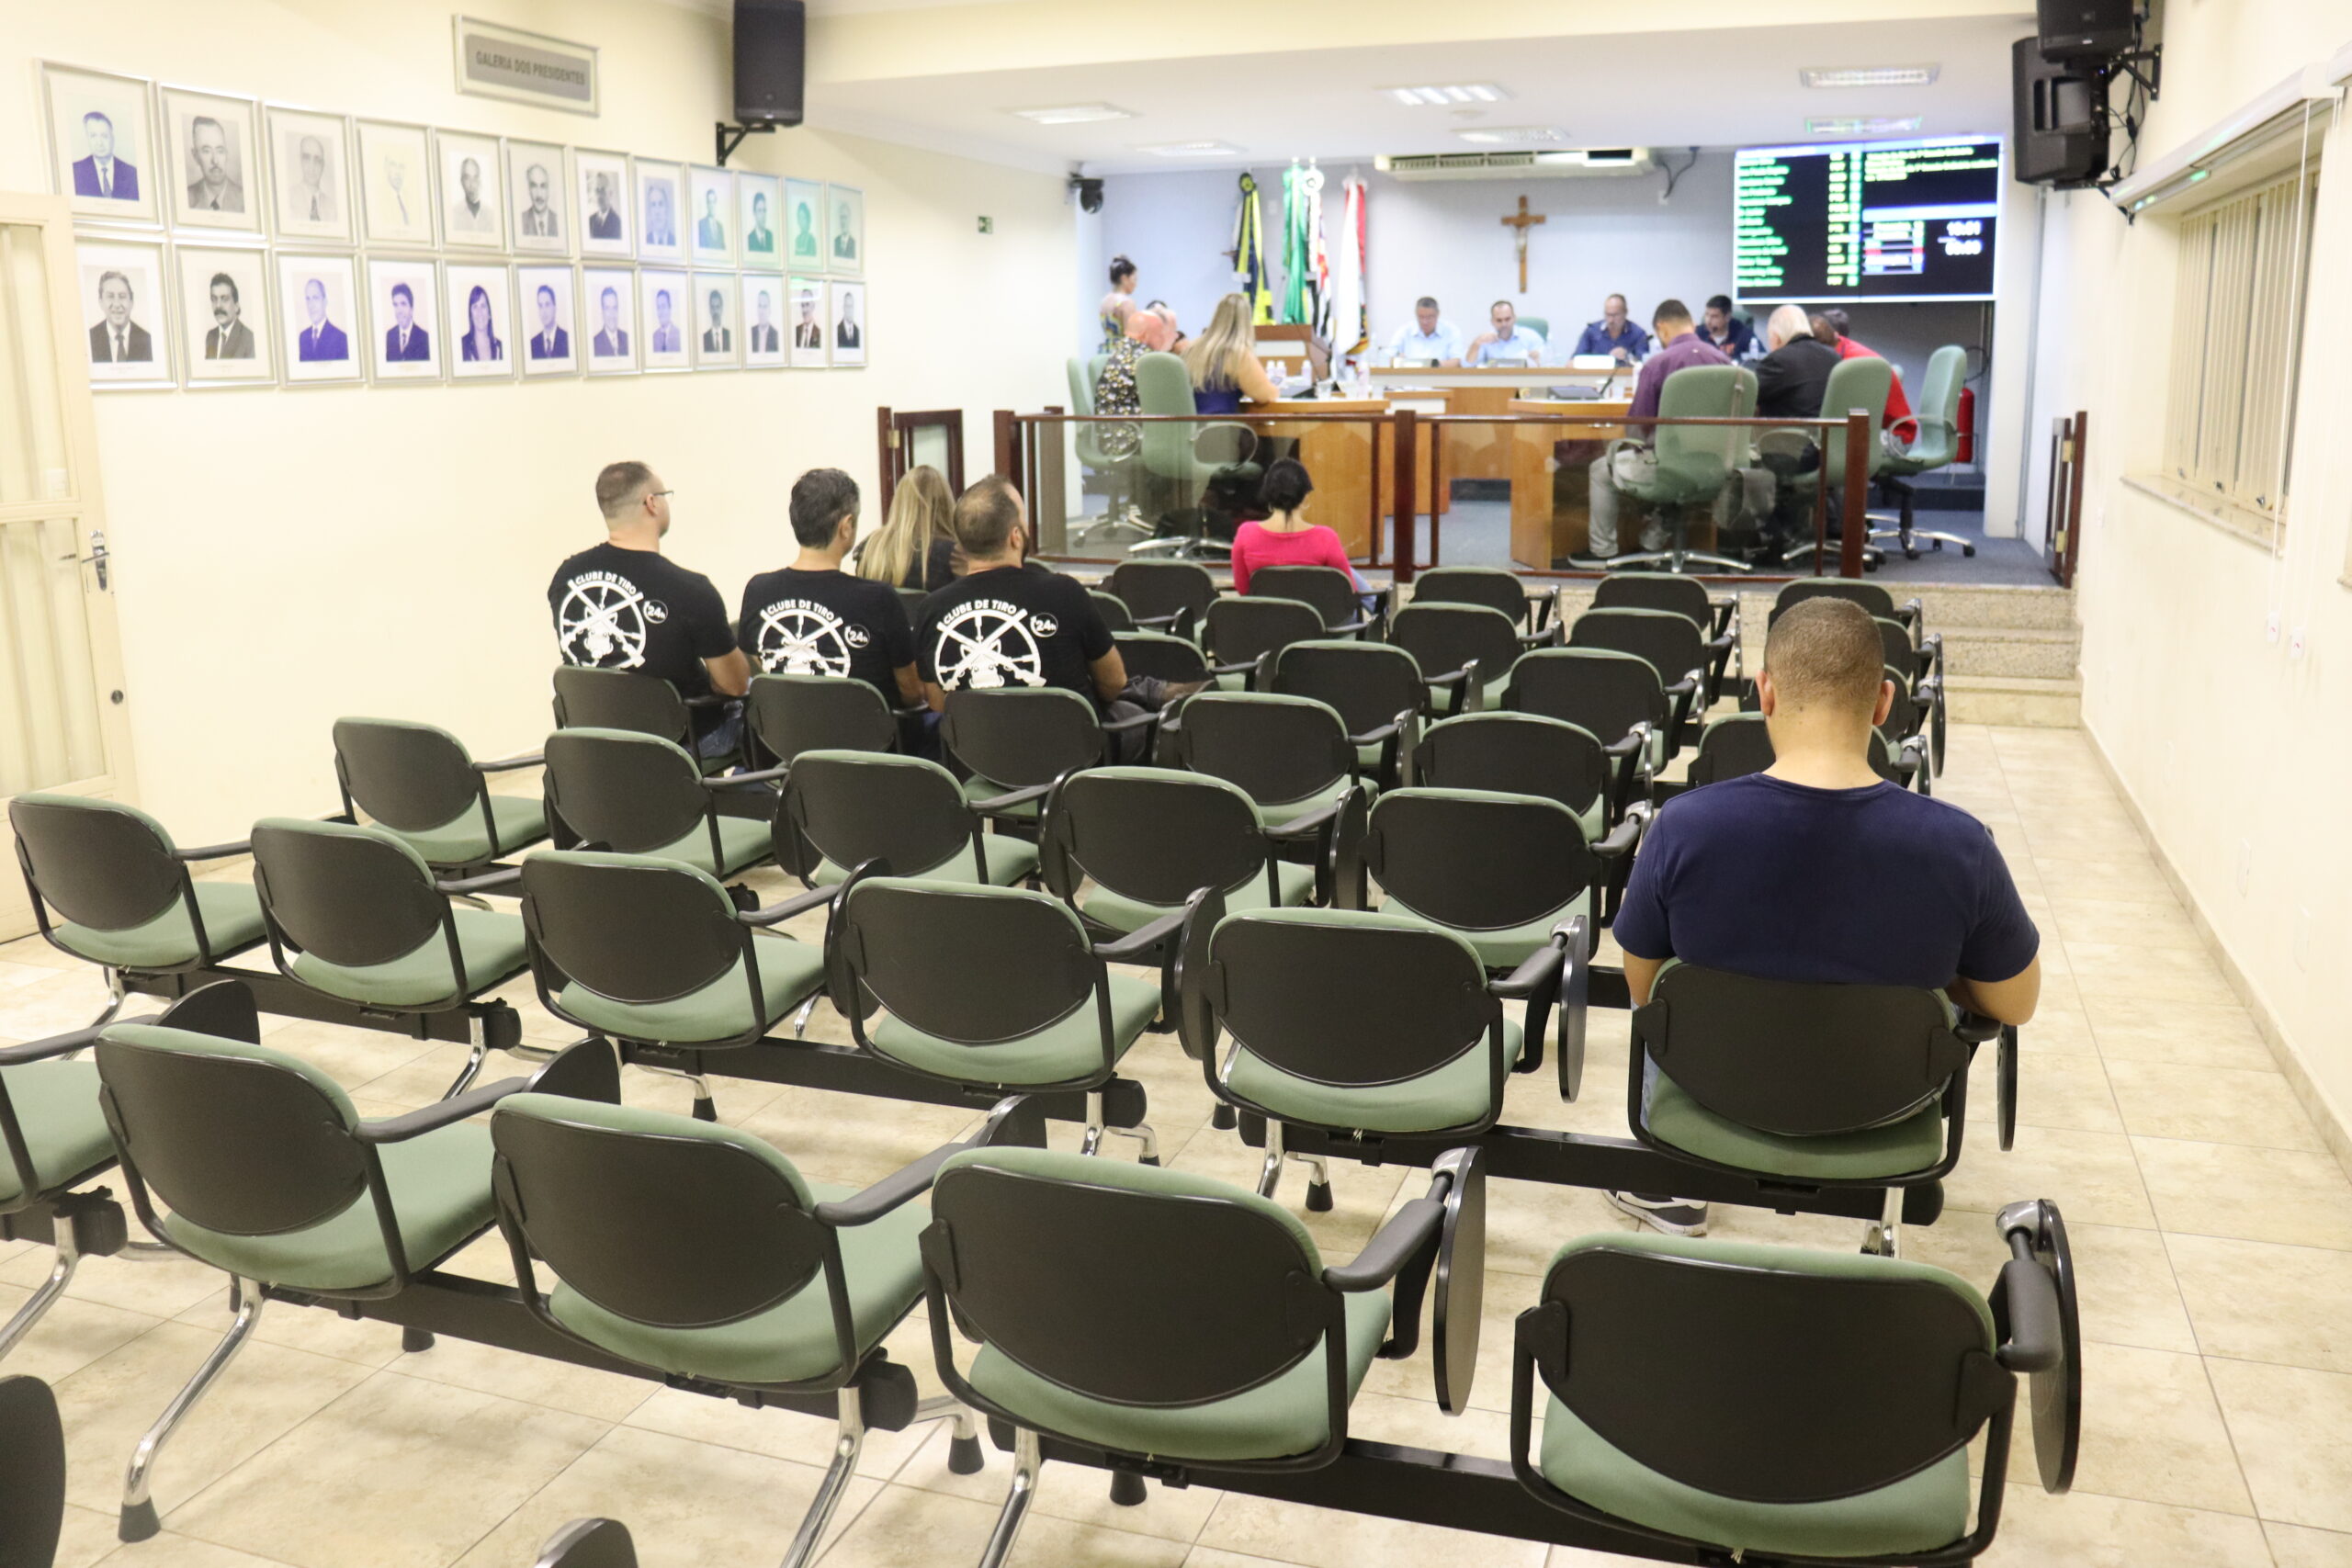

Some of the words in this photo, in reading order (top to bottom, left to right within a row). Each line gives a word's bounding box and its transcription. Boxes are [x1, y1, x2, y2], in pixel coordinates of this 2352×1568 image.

[475, 51, 512, 70] GALERIA
[514, 60, 531, 75] DOS
[533, 62, 585, 85] PRESIDENTES
[575, 570, 604, 585] CLUBE
[605, 571, 618, 583] DE
[617, 576, 637, 595] TIRO
[767, 599, 797, 615] CLUBE
[798, 599, 812, 611] DE
[813, 602, 835, 621] TIRO
[943, 602, 973, 625] CLUBE
[974, 599, 989, 610] DE
[991, 599, 1017, 615] TIRO
